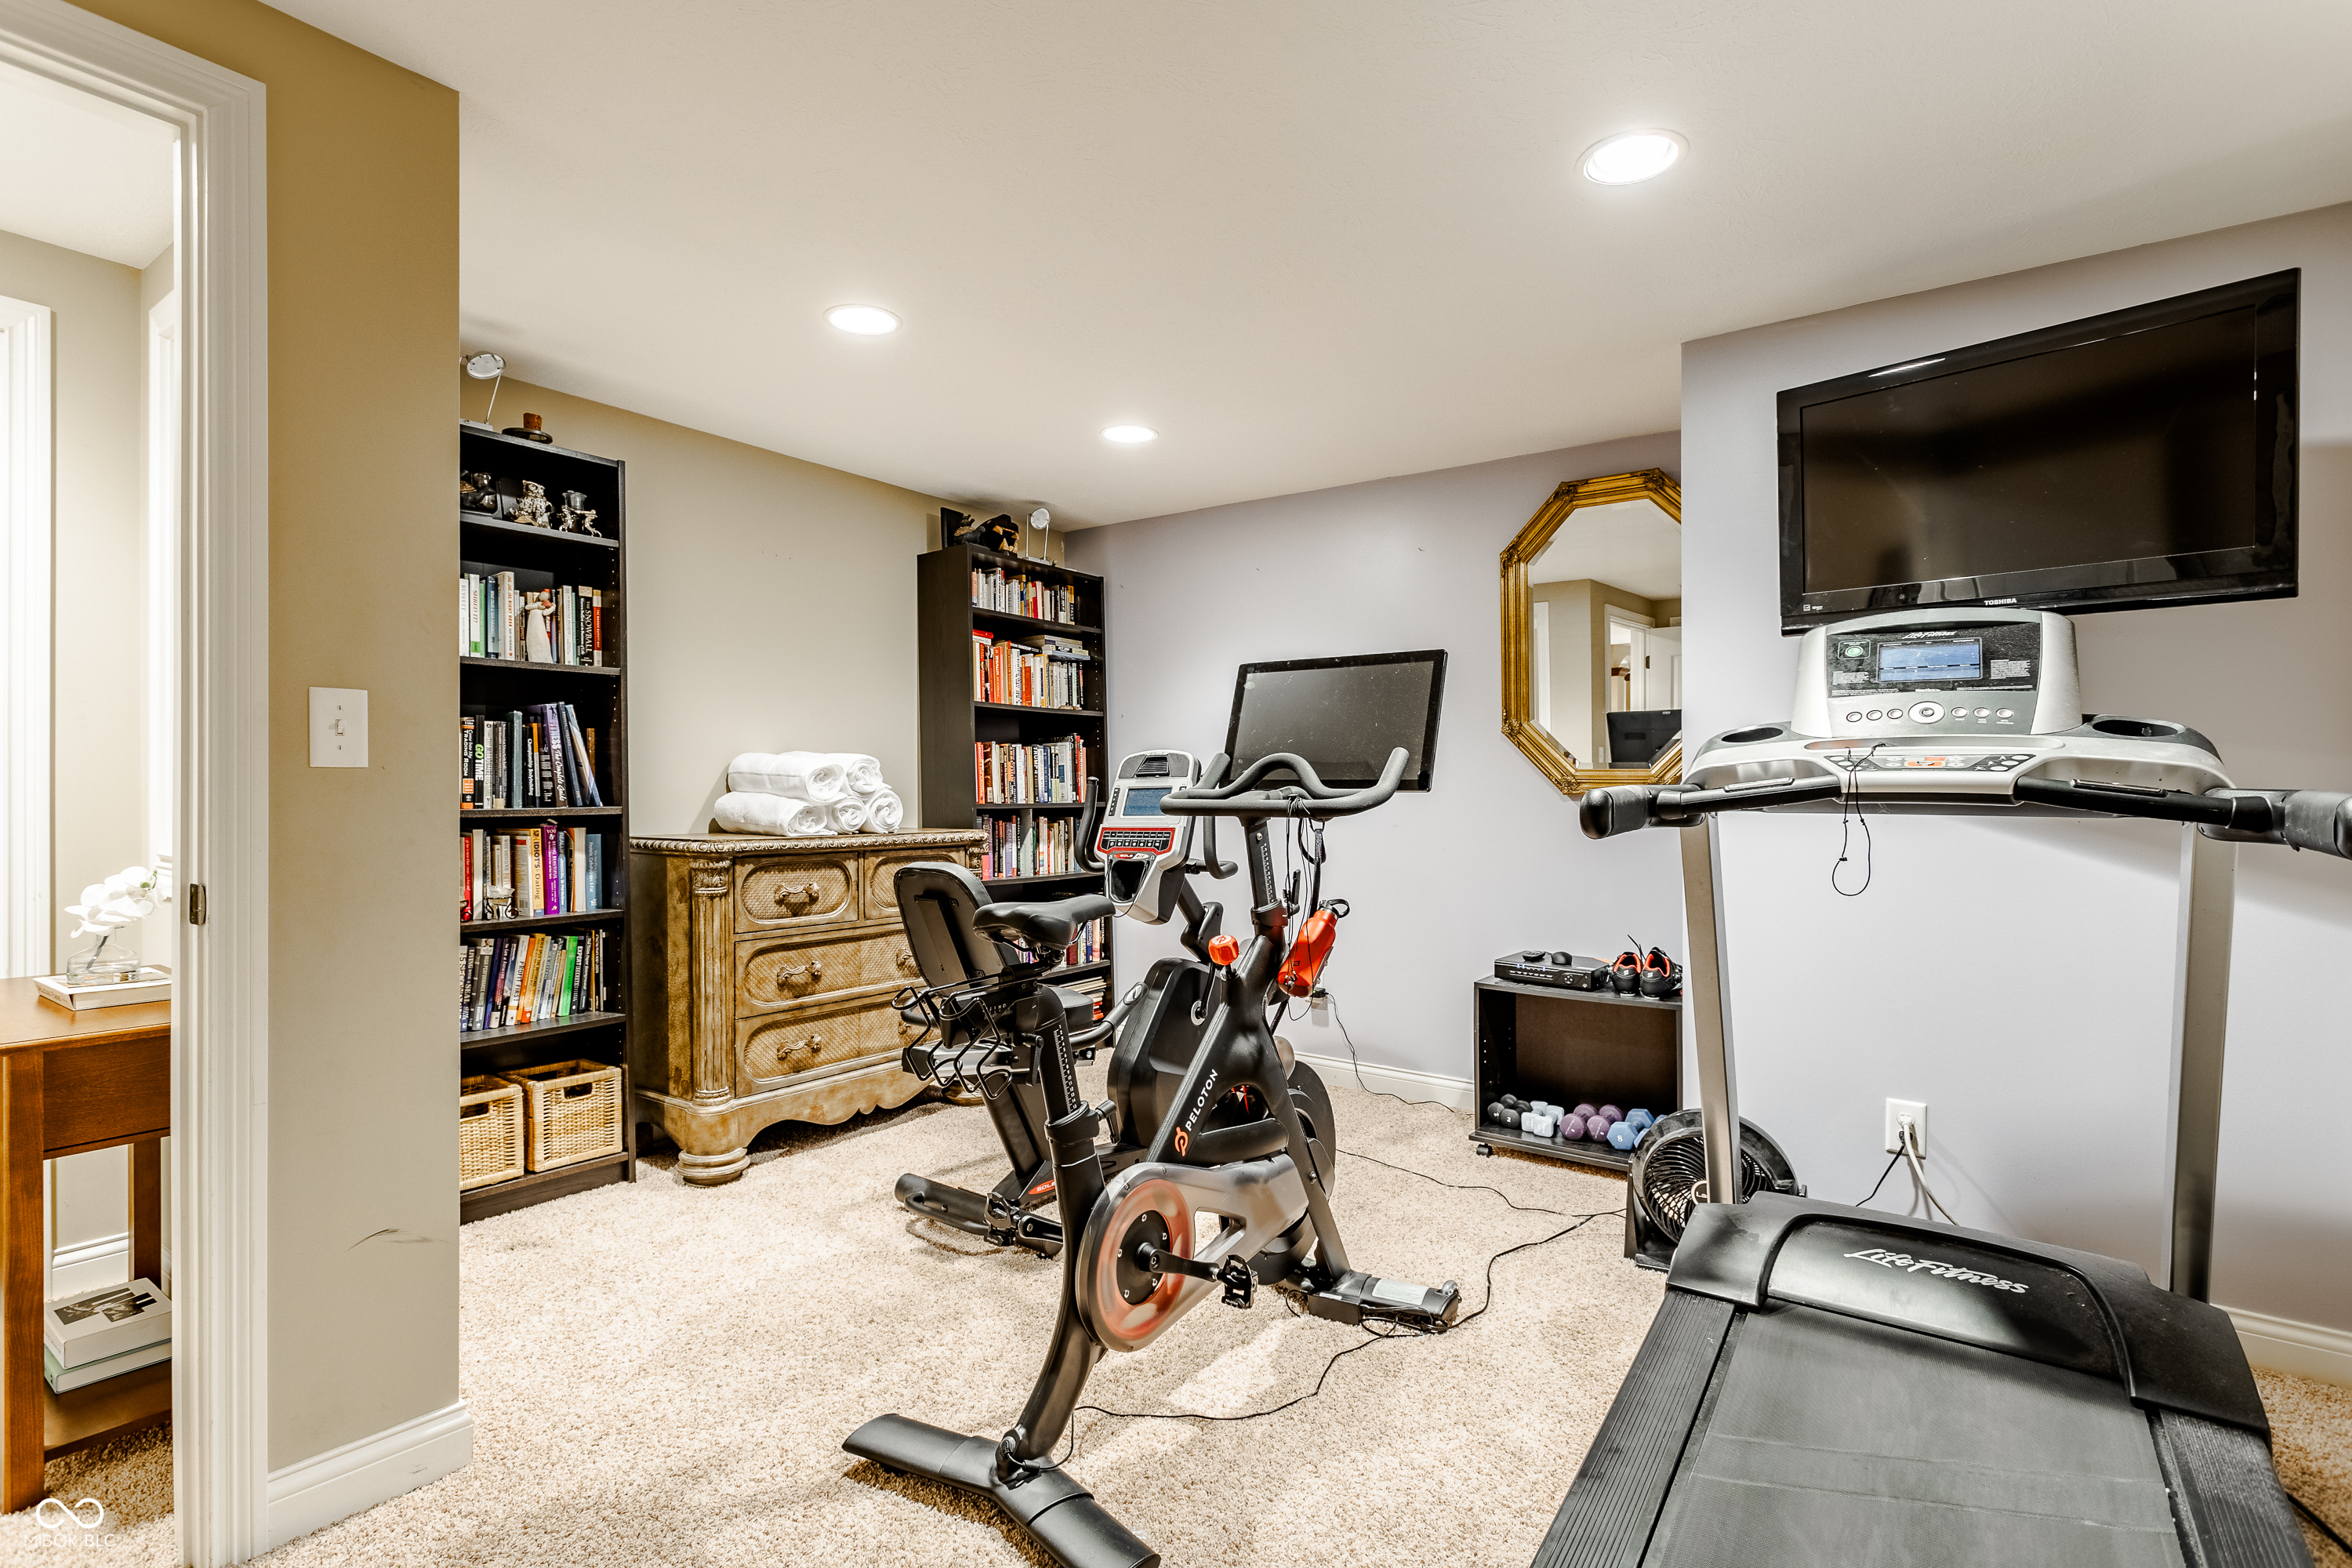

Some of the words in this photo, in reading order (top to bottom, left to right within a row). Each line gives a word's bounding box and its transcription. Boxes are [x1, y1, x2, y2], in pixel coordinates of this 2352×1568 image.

[549, 720, 561, 750] FITNESS
[554, 761, 564, 784] Complete
[480, 965, 489, 992] PERFORMANCE
[516, 960, 524, 982] PROFIT
[463, 984, 472, 1004] SEAL
[514, 985, 522, 1002] FIRST
[1185, 1069, 1218, 1131] PELOTON
[1036, 1181, 1056, 1192] SOLE
